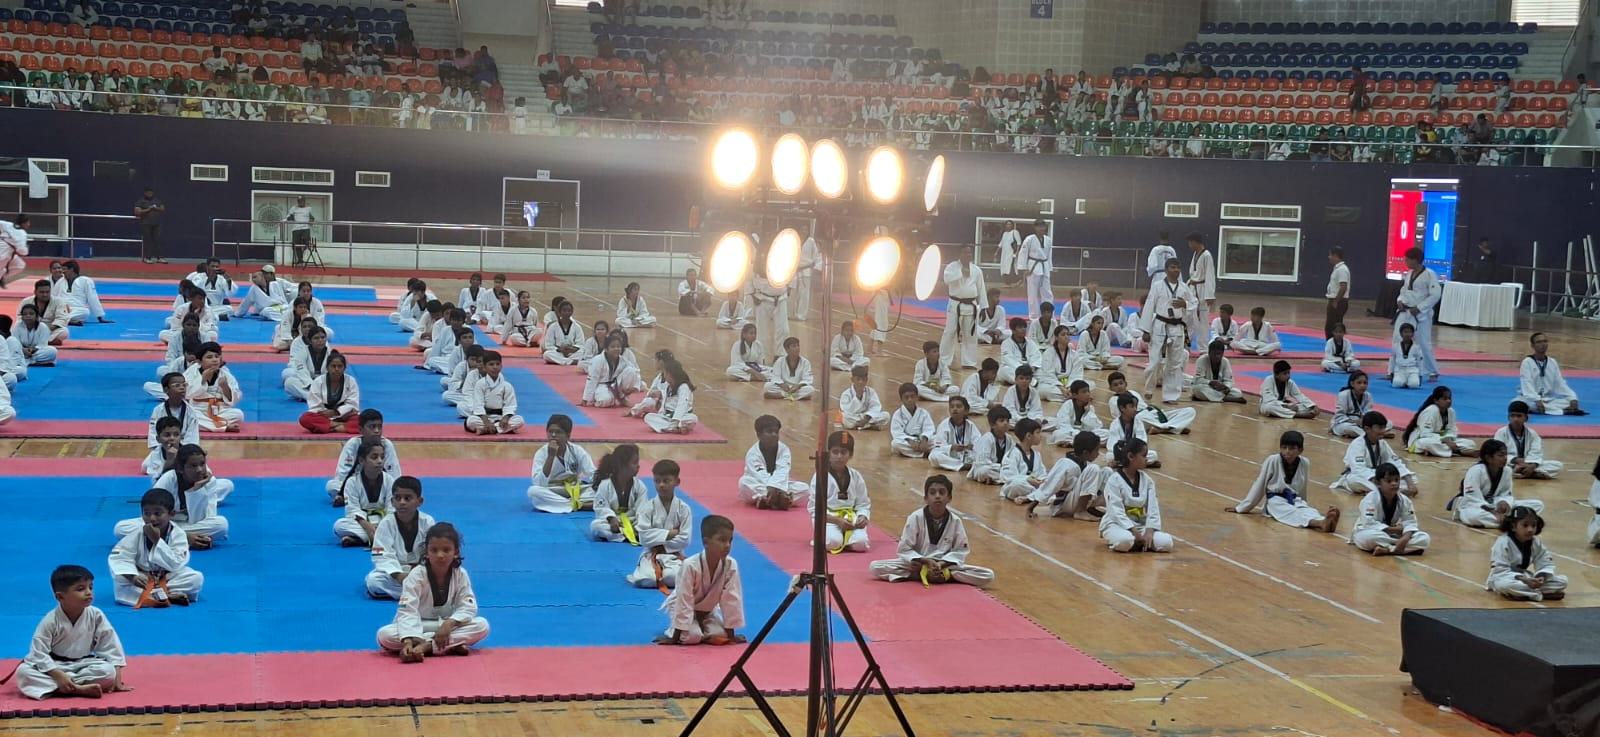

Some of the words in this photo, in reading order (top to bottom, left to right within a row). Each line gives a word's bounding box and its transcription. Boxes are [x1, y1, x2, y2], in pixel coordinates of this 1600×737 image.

[1038, 5, 1045, 16] 4
[1401, 221, 1407, 239] 0
[1433, 223, 1440, 241] 0
